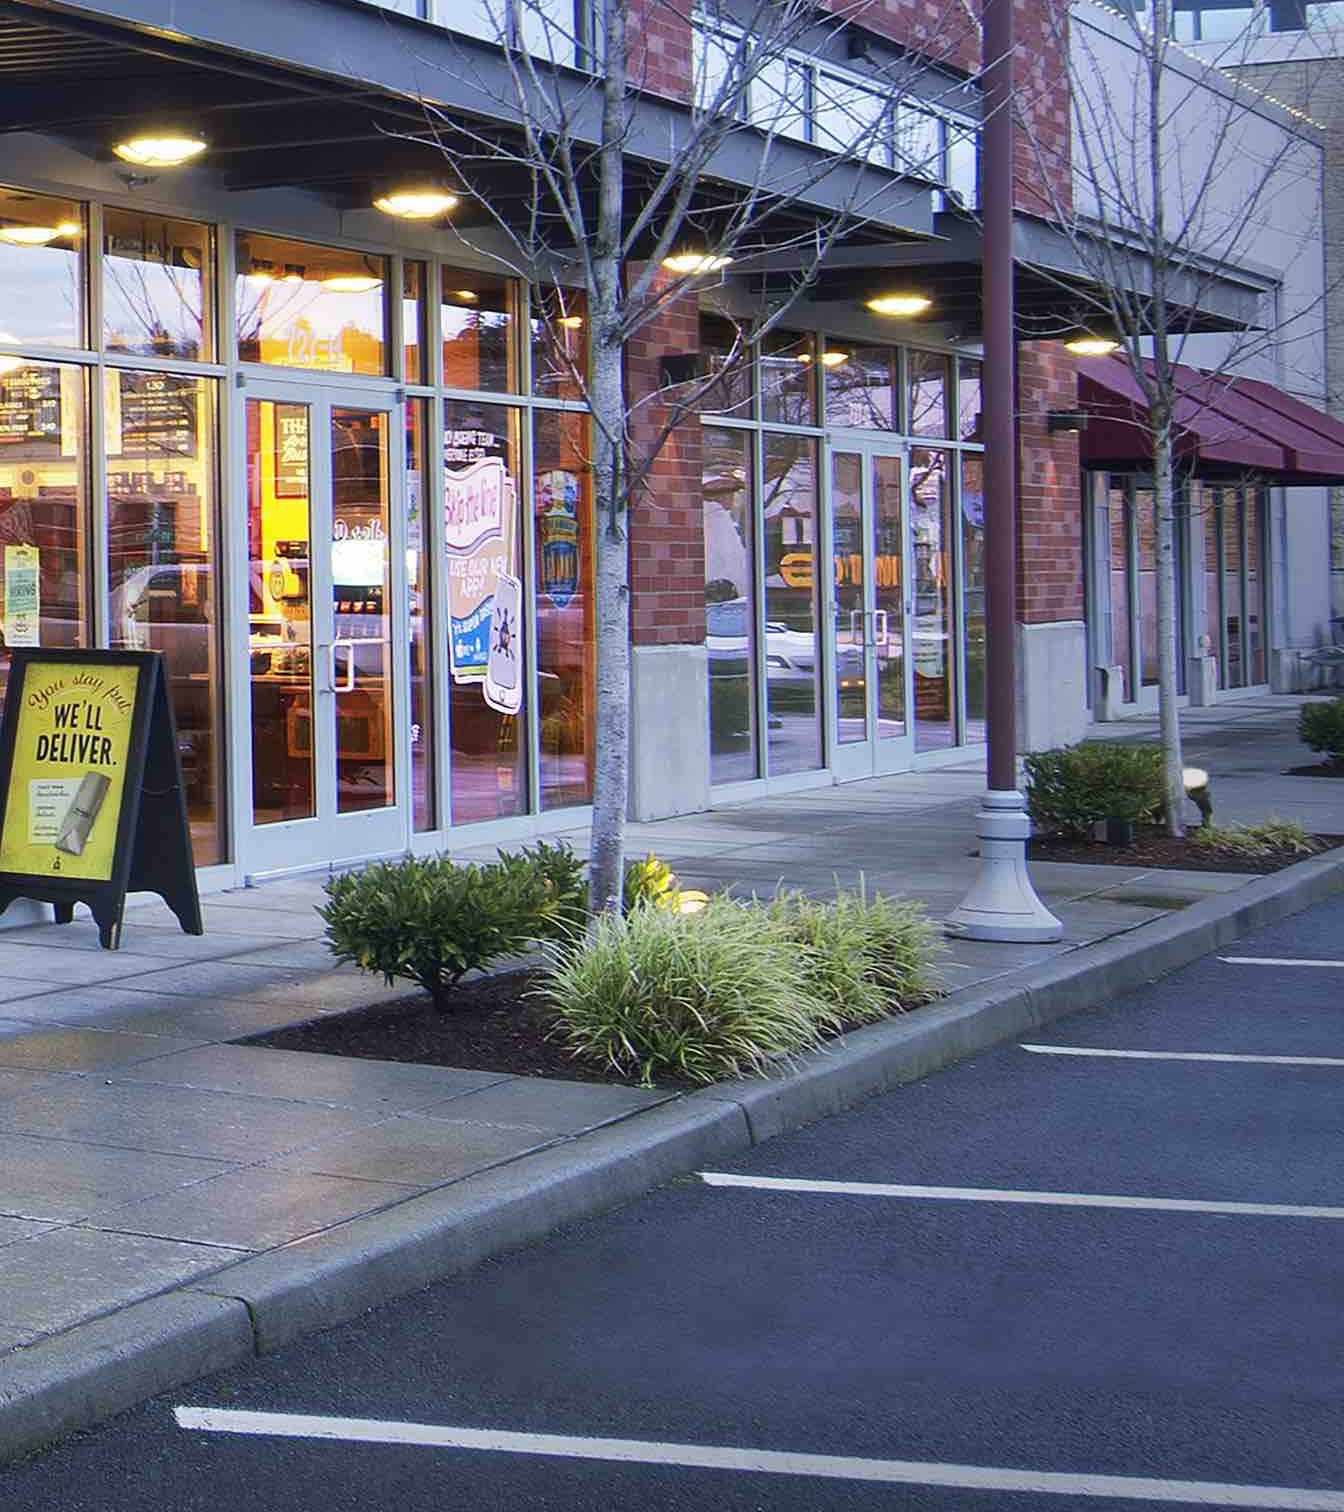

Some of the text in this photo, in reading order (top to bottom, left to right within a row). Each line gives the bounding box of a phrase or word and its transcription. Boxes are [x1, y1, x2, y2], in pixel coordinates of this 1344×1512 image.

[28, 679, 64, 710] You
[72, 672, 104, 695] stay
[54, 699, 103, 731] WE'LL
[36, 733, 117, 765] DELIVER.
